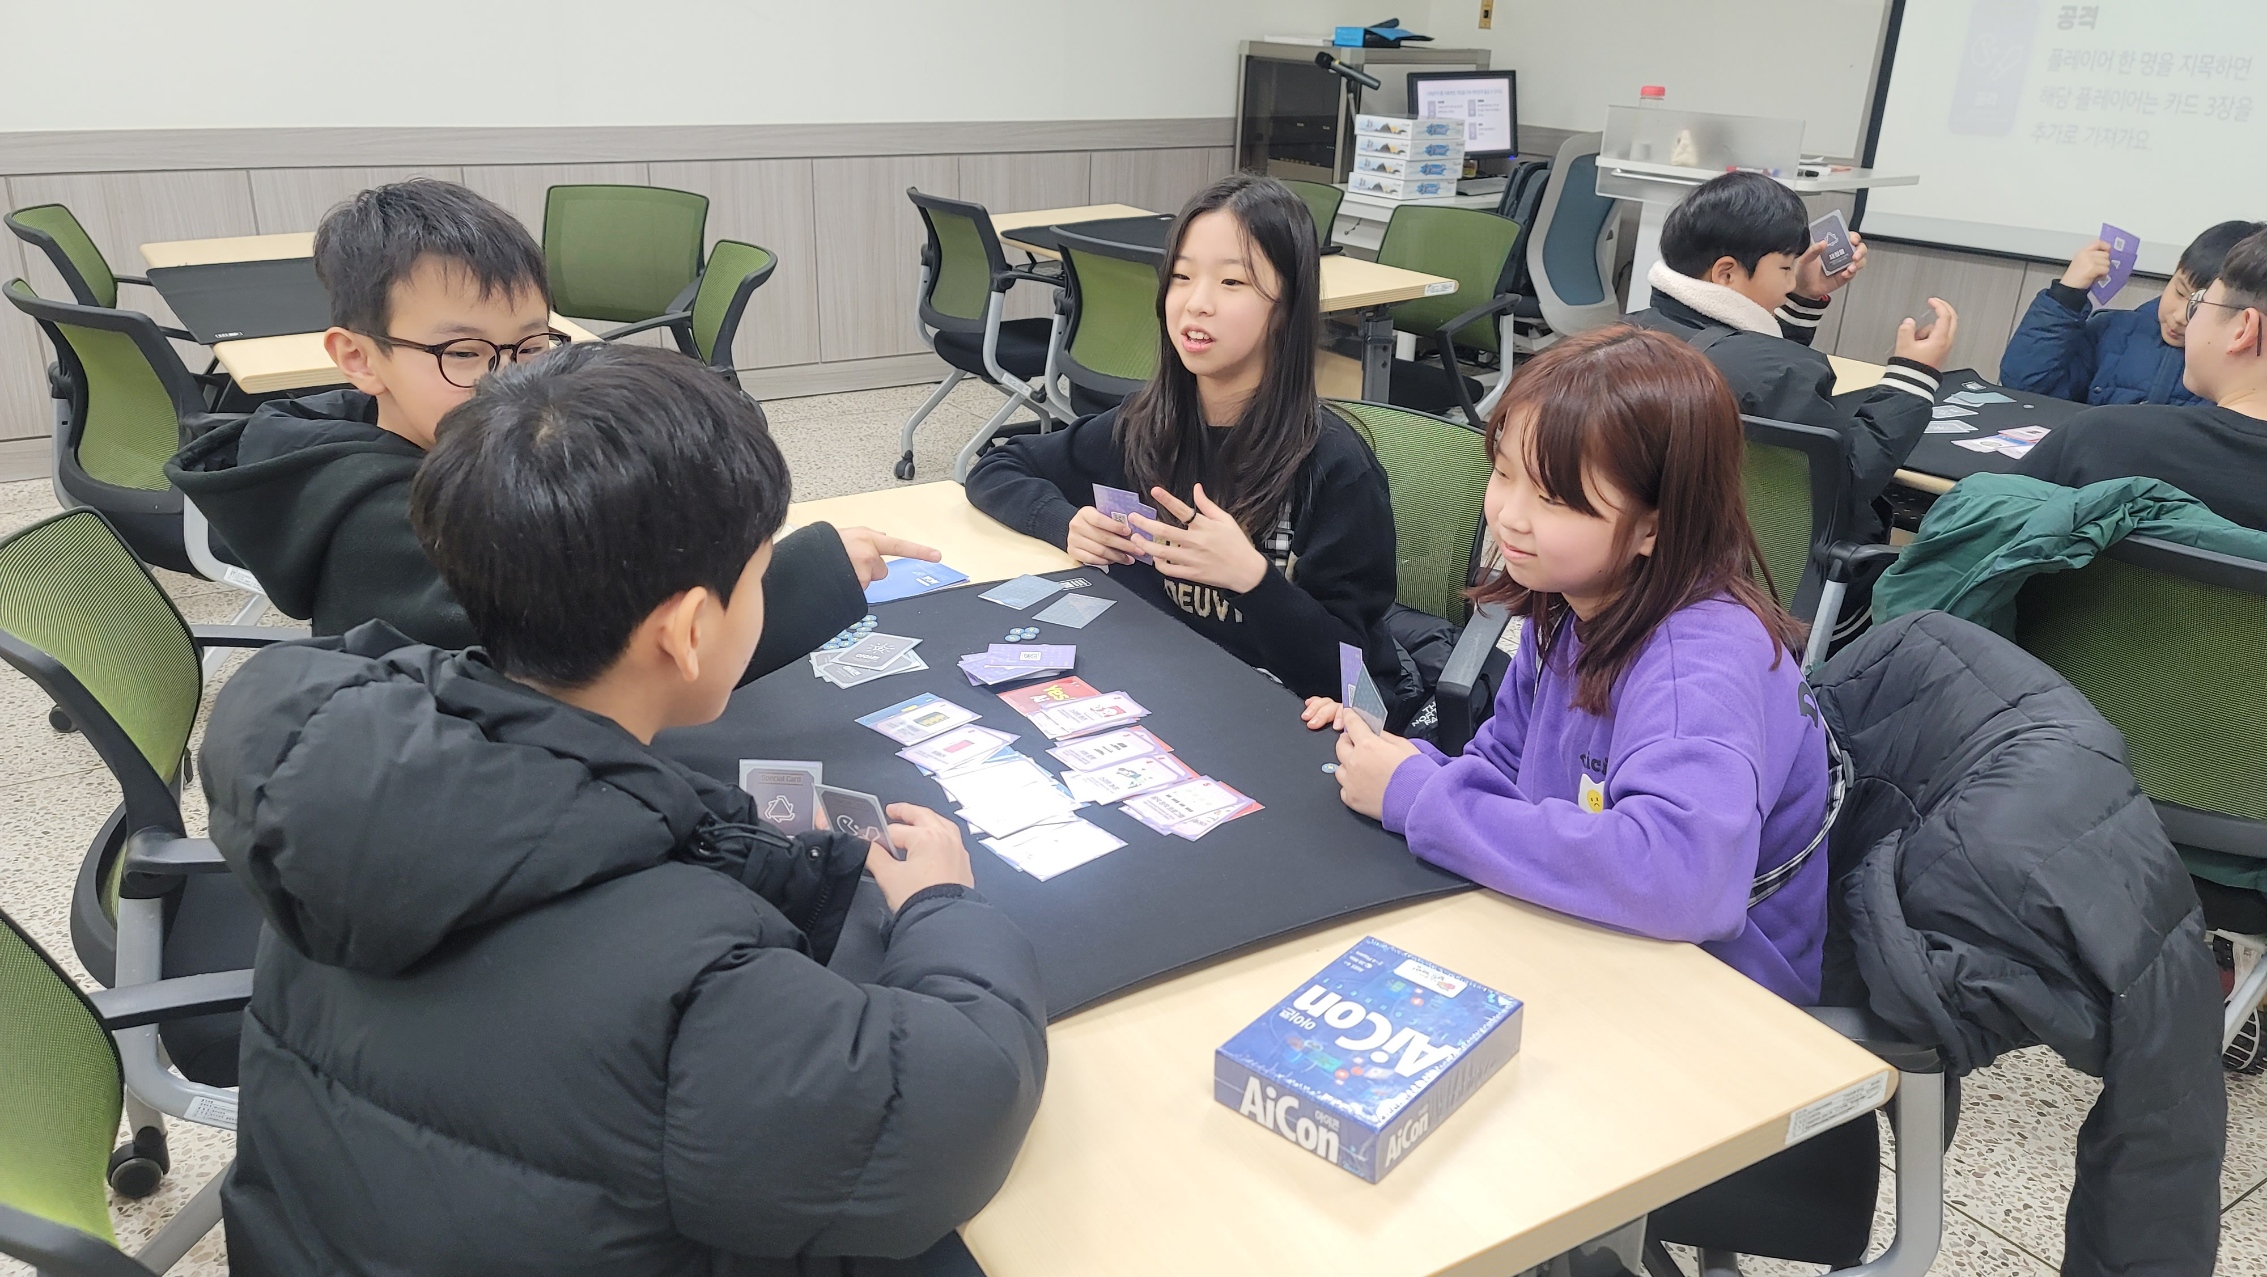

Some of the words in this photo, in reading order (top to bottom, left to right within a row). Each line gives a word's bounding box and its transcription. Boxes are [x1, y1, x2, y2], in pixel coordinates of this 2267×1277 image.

[2056, 4, 2100, 31] 공격
[2047, 48, 2115, 74] 플레이어
[2118, 50, 2137, 76] 한
[2139, 51, 2176, 79] 명을
[2178, 52, 2253, 82] 지목하면
[2039, 85, 2074, 111] 해당
[2075, 86, 2160, 116] 플레이어는
[2163, 90, 2201, 116] 카드
[2203, 94, 2254, 123] 3장을
[2030, 121, 2079, 146] 추가로
[1411, 708, 1438, 728] NORT
[761, 774, 785, 783] Special
[786, 775, 802, 784] Card
[1278, 1007, 1317, 1031] 아이콘
[1292, 983, 1463, 1079] AiCon
[1239, 1075, 1340, 1165] AiCon
[1314, 1109, 1341, 1132] 아이콘
[1385, 1112, 1429, 1168] AiCon
